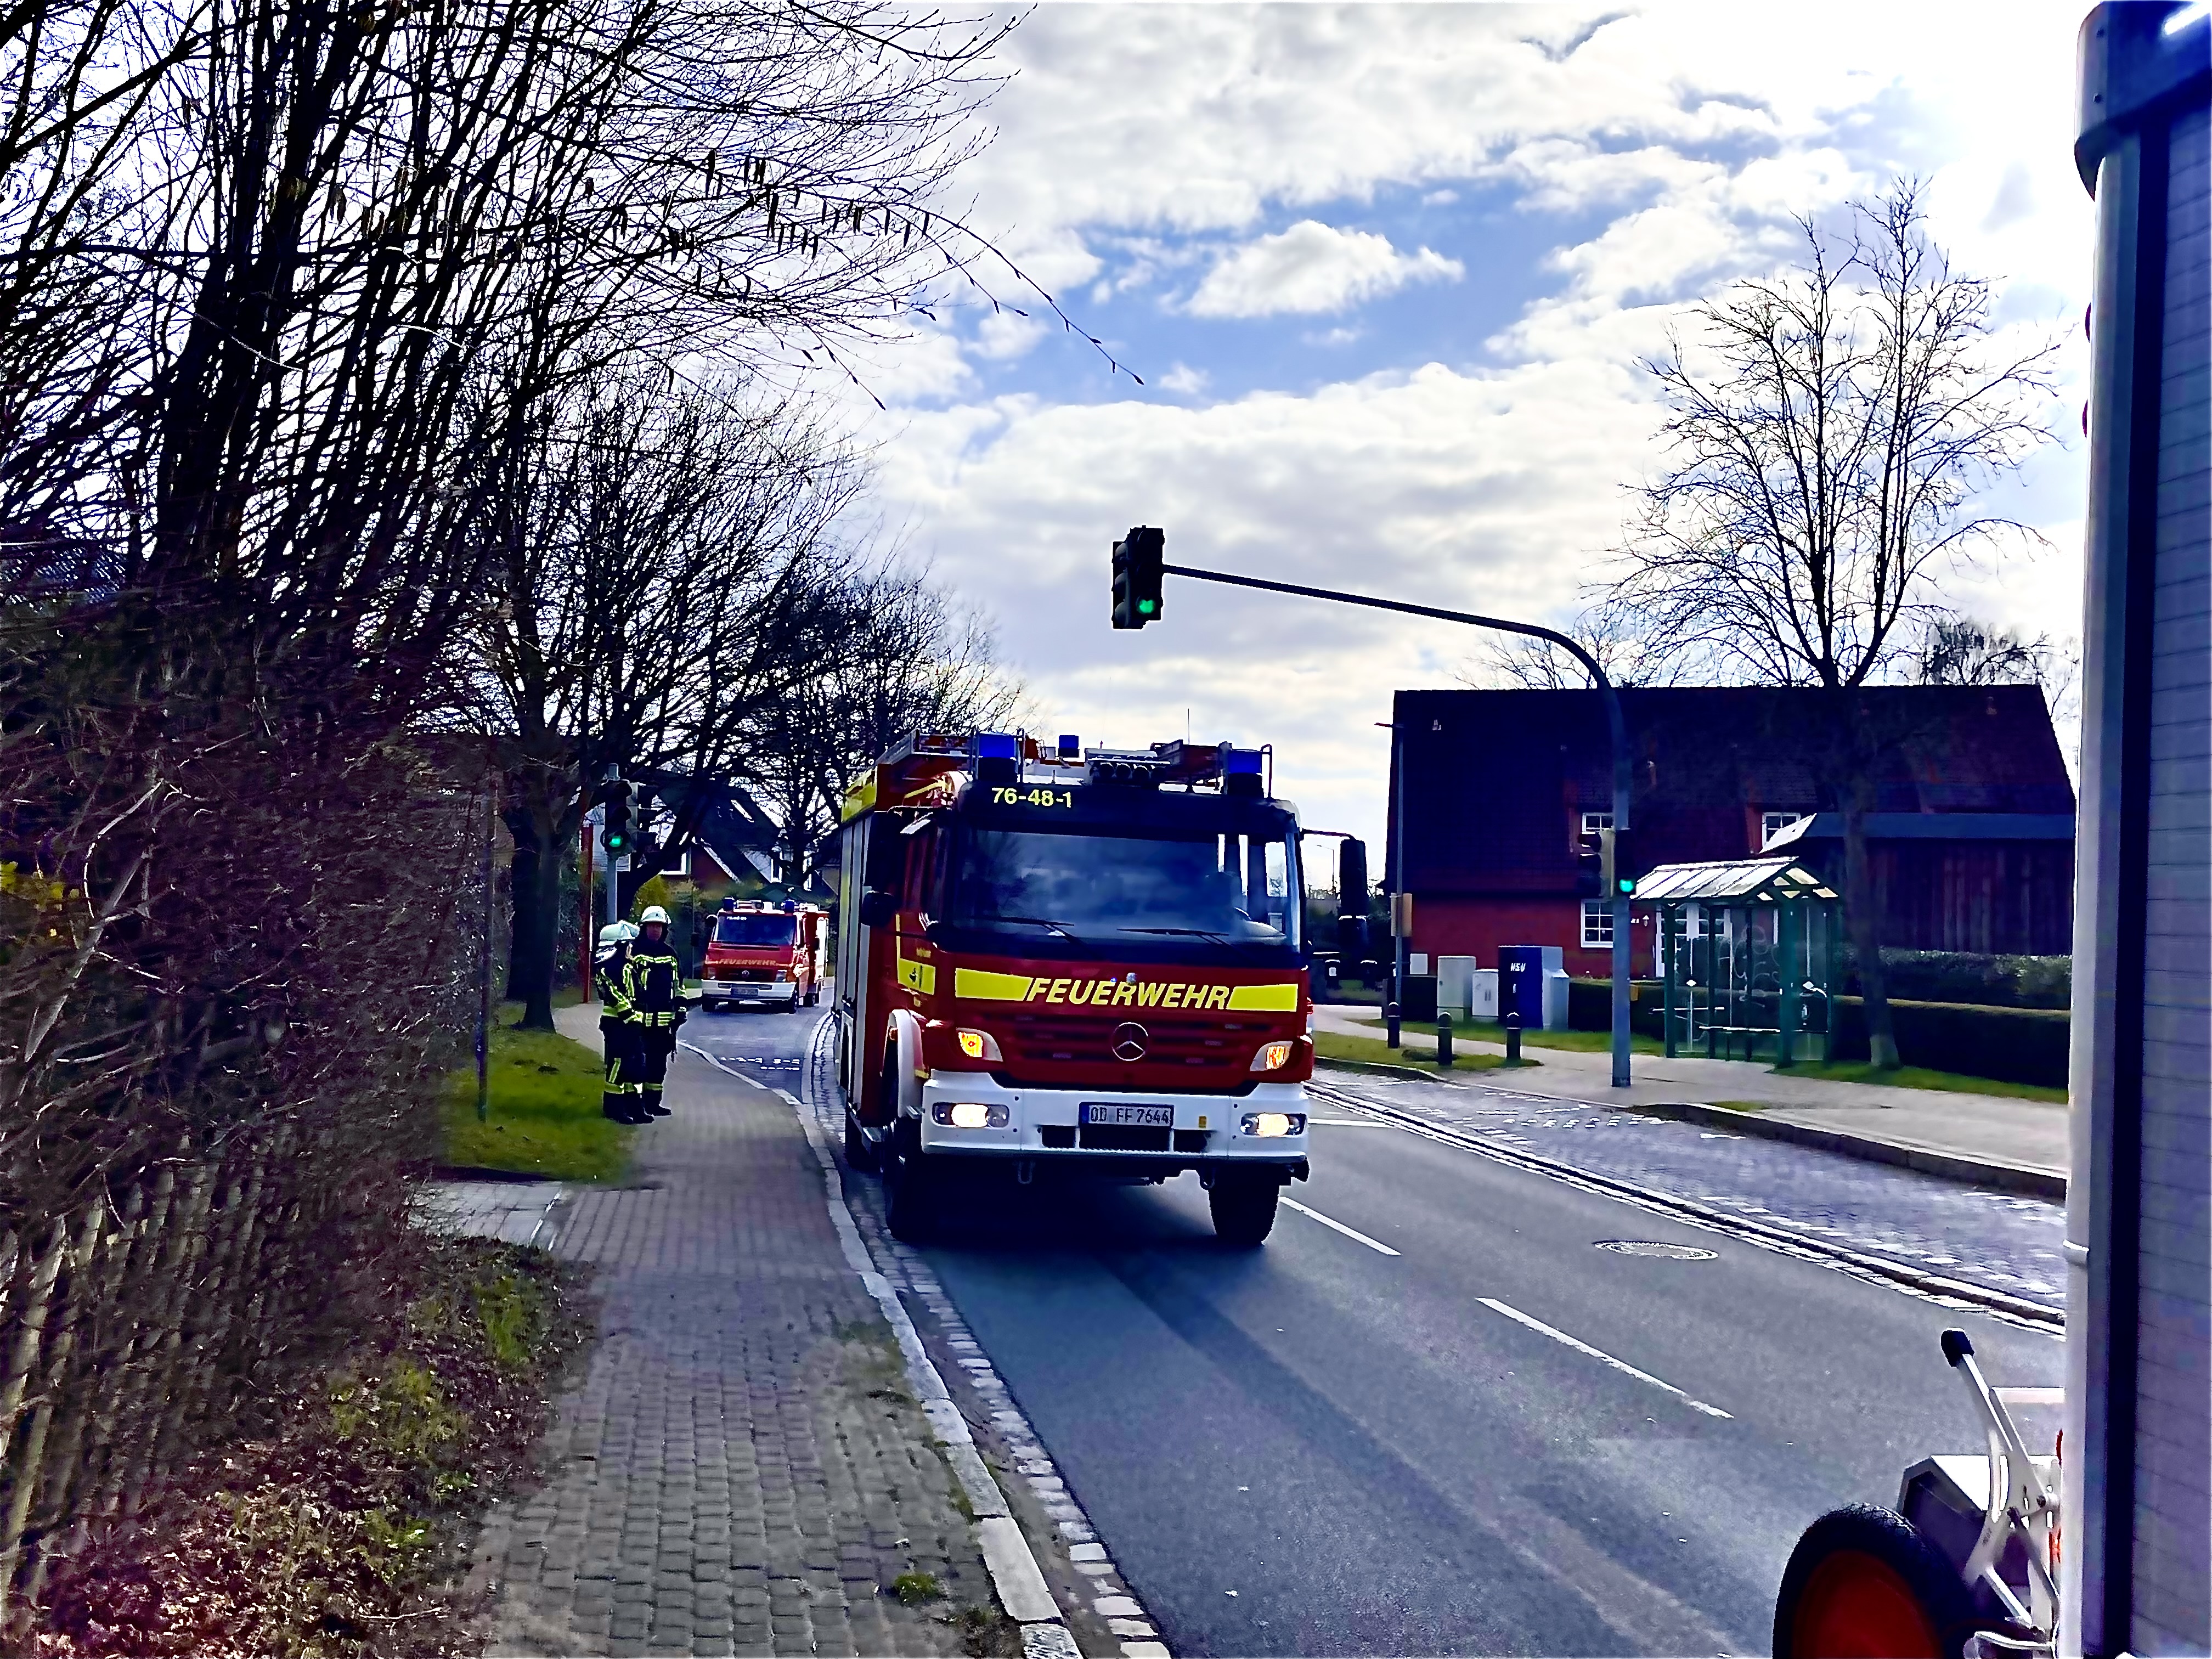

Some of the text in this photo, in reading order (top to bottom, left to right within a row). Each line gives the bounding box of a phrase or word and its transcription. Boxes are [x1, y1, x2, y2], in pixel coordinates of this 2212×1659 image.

[991, 787, 1071, 808] 76-48-1
[1026, 978, 1229, 1009] FEUERWEHR
[1090, 1107, 1169, 1124] OD FF 7644
